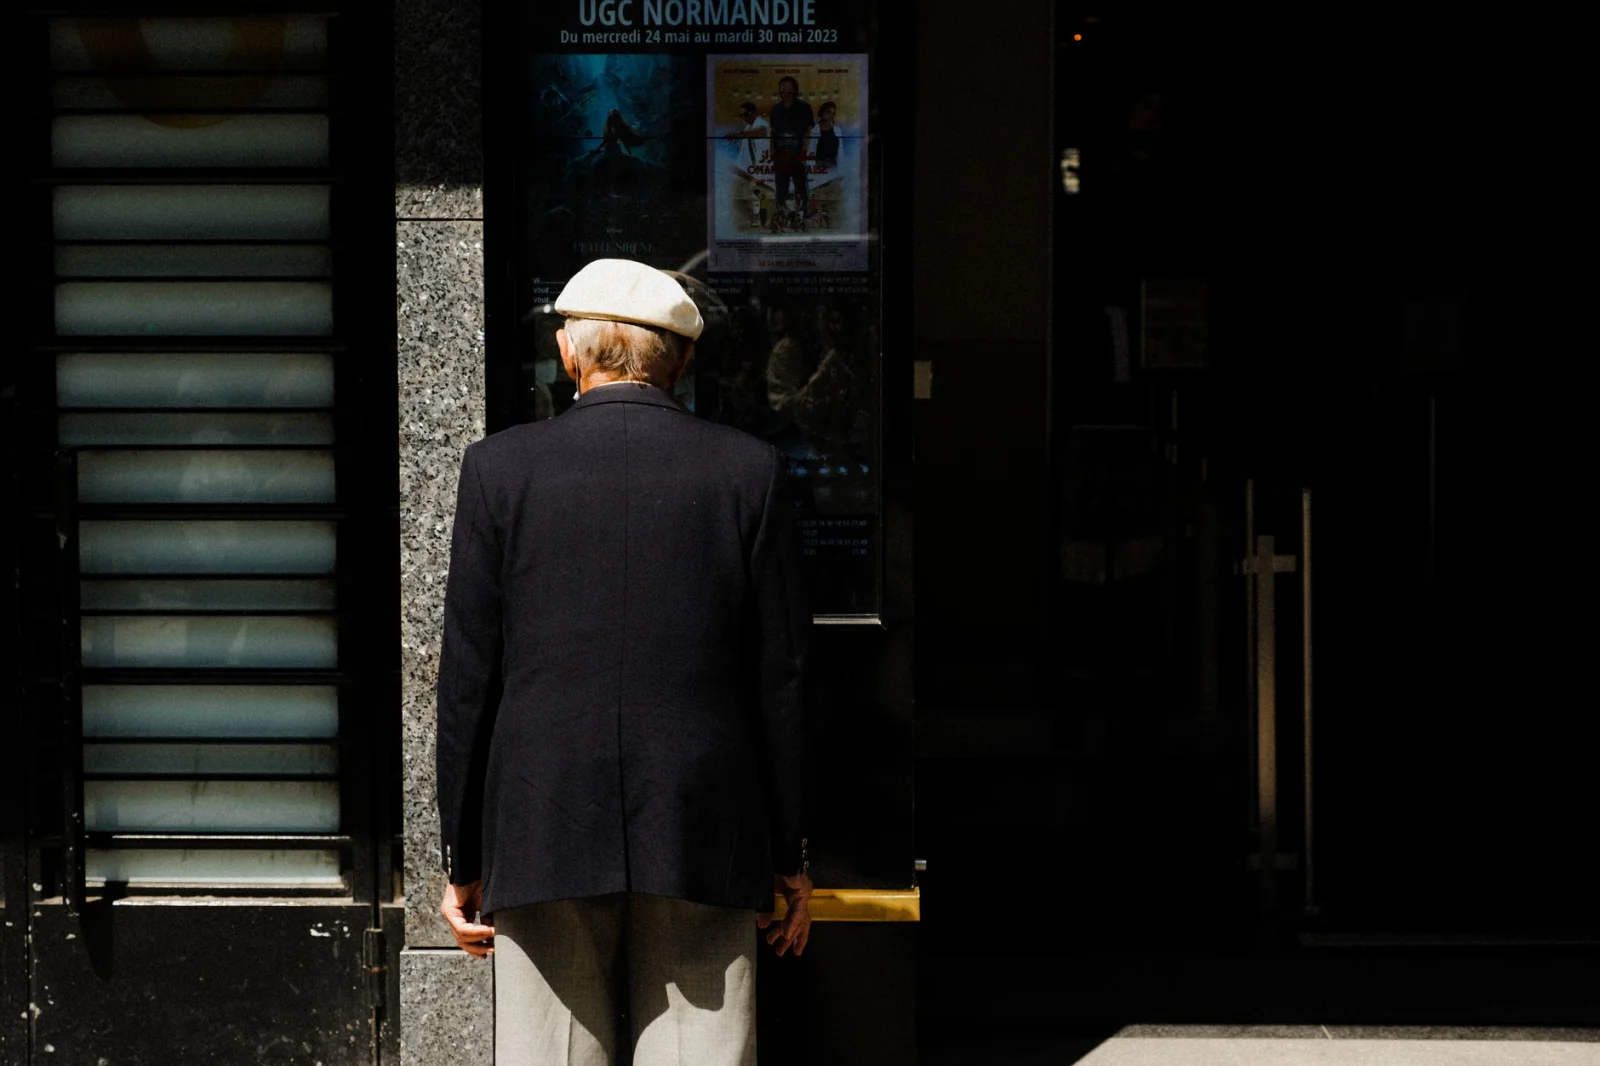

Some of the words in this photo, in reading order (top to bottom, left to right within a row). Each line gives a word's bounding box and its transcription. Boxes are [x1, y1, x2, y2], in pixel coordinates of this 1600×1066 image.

[579, 0, 633, 27] UGC
[643, 0, 816, 26] NORMANDIE
[560, 29, 578, 43] Du
[582, 29, 641, 43] mercredi
[645, 29, 661, 43] 24
[664, 29, 690, 43] mai
[694, 31, 710, 43] au
[714, 29, 753, 43] mardi
[757, 29, 774, 43] 30
[777, 29, 803, 43] mai
[806, 29, 838, 43] 2023
